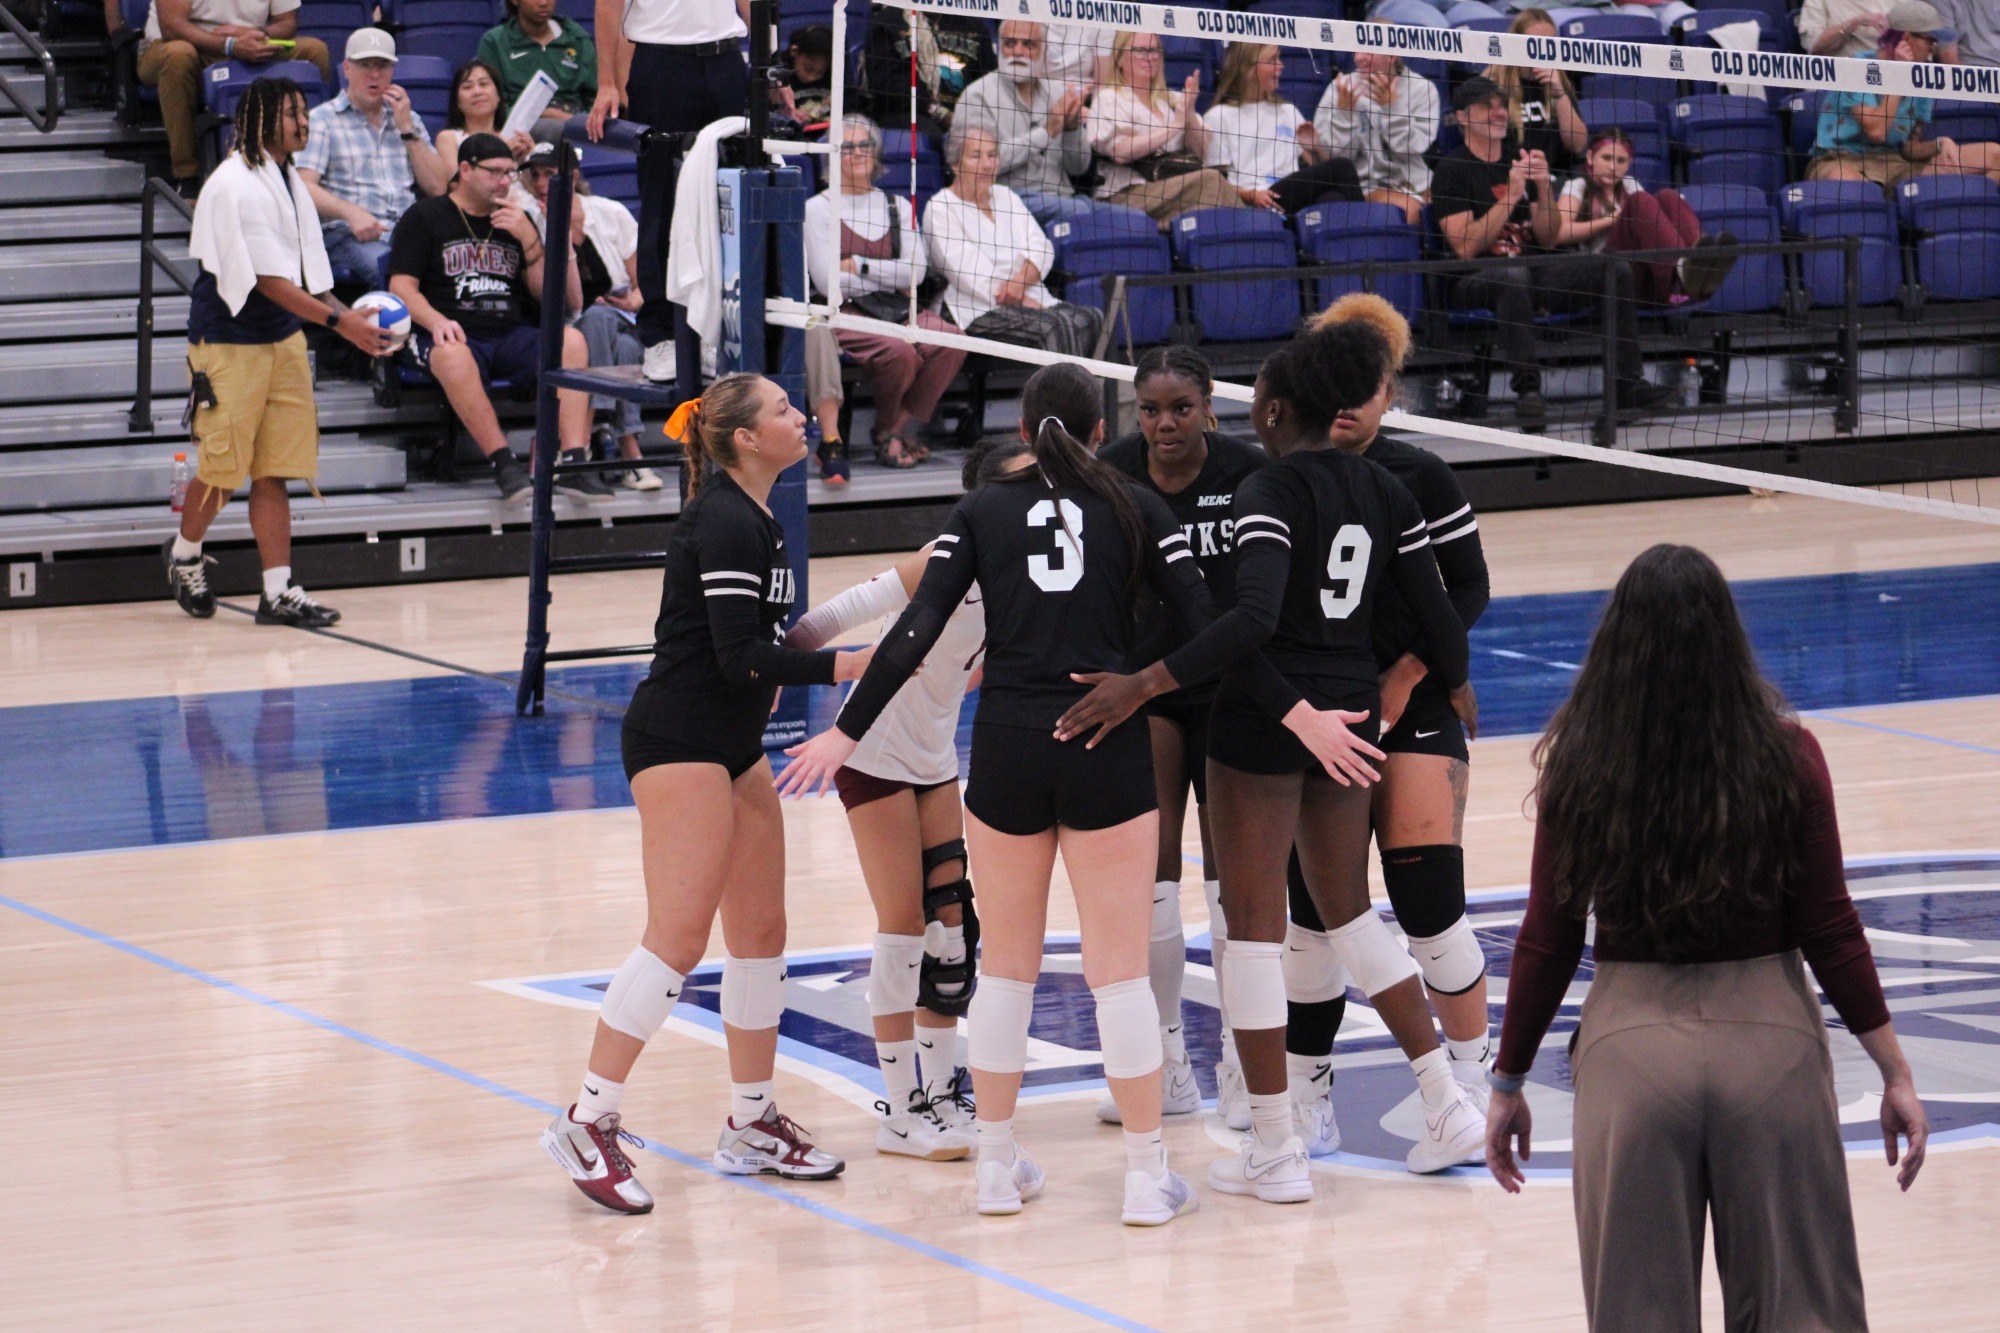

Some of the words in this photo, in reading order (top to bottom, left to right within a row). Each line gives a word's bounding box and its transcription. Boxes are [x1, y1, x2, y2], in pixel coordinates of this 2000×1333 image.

[1050, 0, 1072, 18] OLD
[1077, 1, 1141, 25] DOMINION
[1197, 11, 1222, 33] OLD
[1227, 13, 1297, 39] DOMINION
[1356, 25, 1383, 46] OLD
[1388, 27, 1462, 53] DOMINION
[1526, 37, 1555, 61] OLD
[1561, 40, 1642, 68] DOMINION
[1711, 50, 1743, 76] OLD
[1749, 52, 1836, 82] DOMINION
[1911, 64, 1946, 90] OLD
[1952, 67, 2000, 94] DOMI
[442, 243, 519, 278] UMES
[454, 272, 511, 299] Father
[1197, 494, 1232, 507] MEAC
[1027, 499, 1084, 592] 3
[1320, 524, 1372, 619] 9
